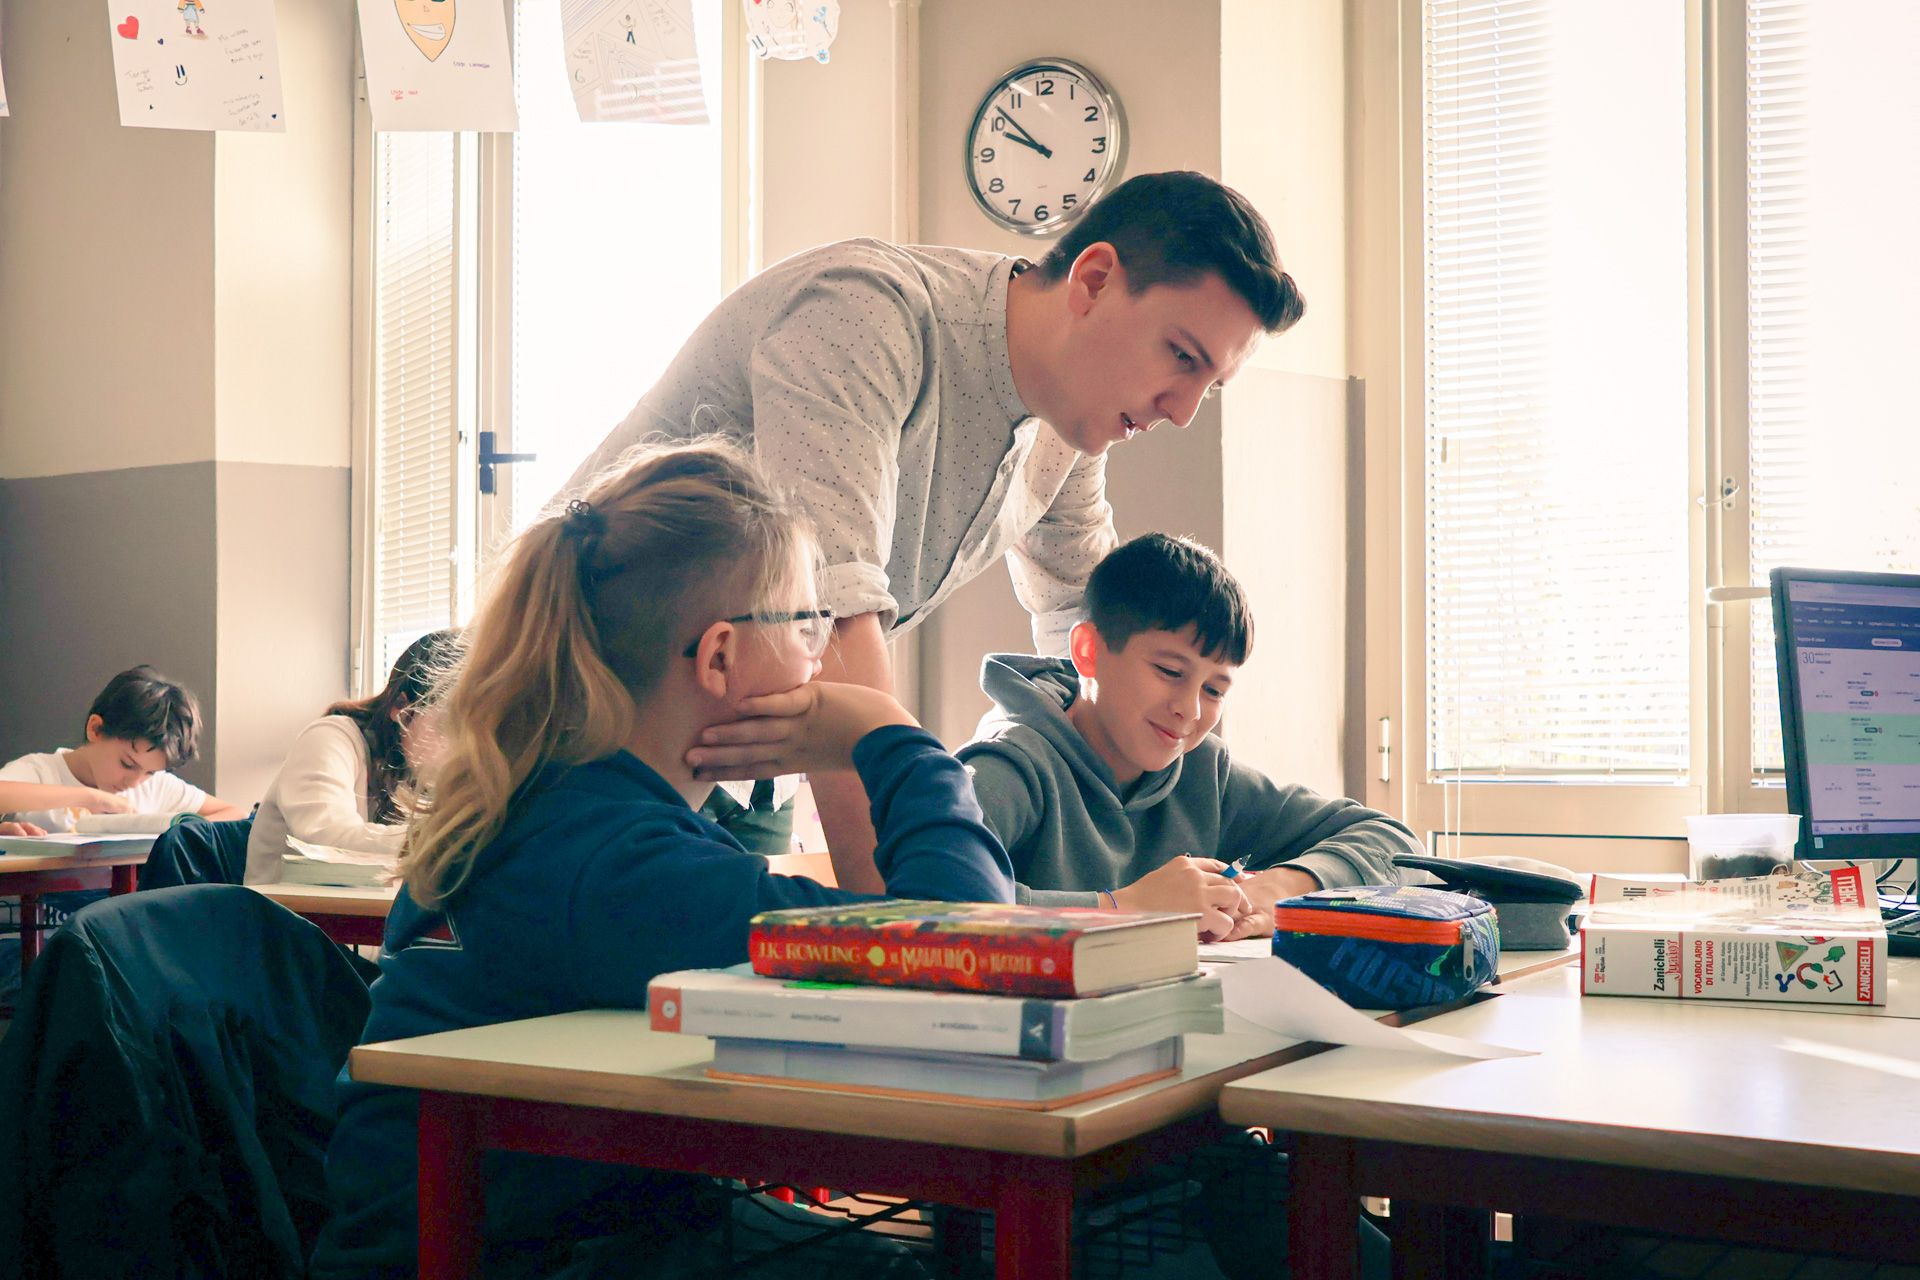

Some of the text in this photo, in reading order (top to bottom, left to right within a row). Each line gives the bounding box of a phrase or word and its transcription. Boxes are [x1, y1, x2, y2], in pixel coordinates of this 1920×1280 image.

[1036, 80, 1054, 96] 12
[1070, 84, 1074, 100] 1
[1011, 93, 1022, 110] 11
[1084, 106, 1098, 122] 2
[991, 116, 1006, 132] 10
[1091, 137, 1106, 154] 3
[980, 147, 995, 163] 9
[1083, 168, 1096, 183] 4
[988, 177, 1005, 193] 8
[1008, 199, 1022, 215] 7
[1062, 194, 1077, 210] 5
[1034, 205, 1049, 221] 6
[785, 943, 861, 964] ROWLING
[1667, 939, 1681, 980] Junior
[1653, 939, 1665, 992] Zanichelli
[1694, 940, 1702, 994] VOCABOLARIO
[1861, 946, 1870, 999] ZANICHELLI
[1706, 978, 1713, 986] DI
